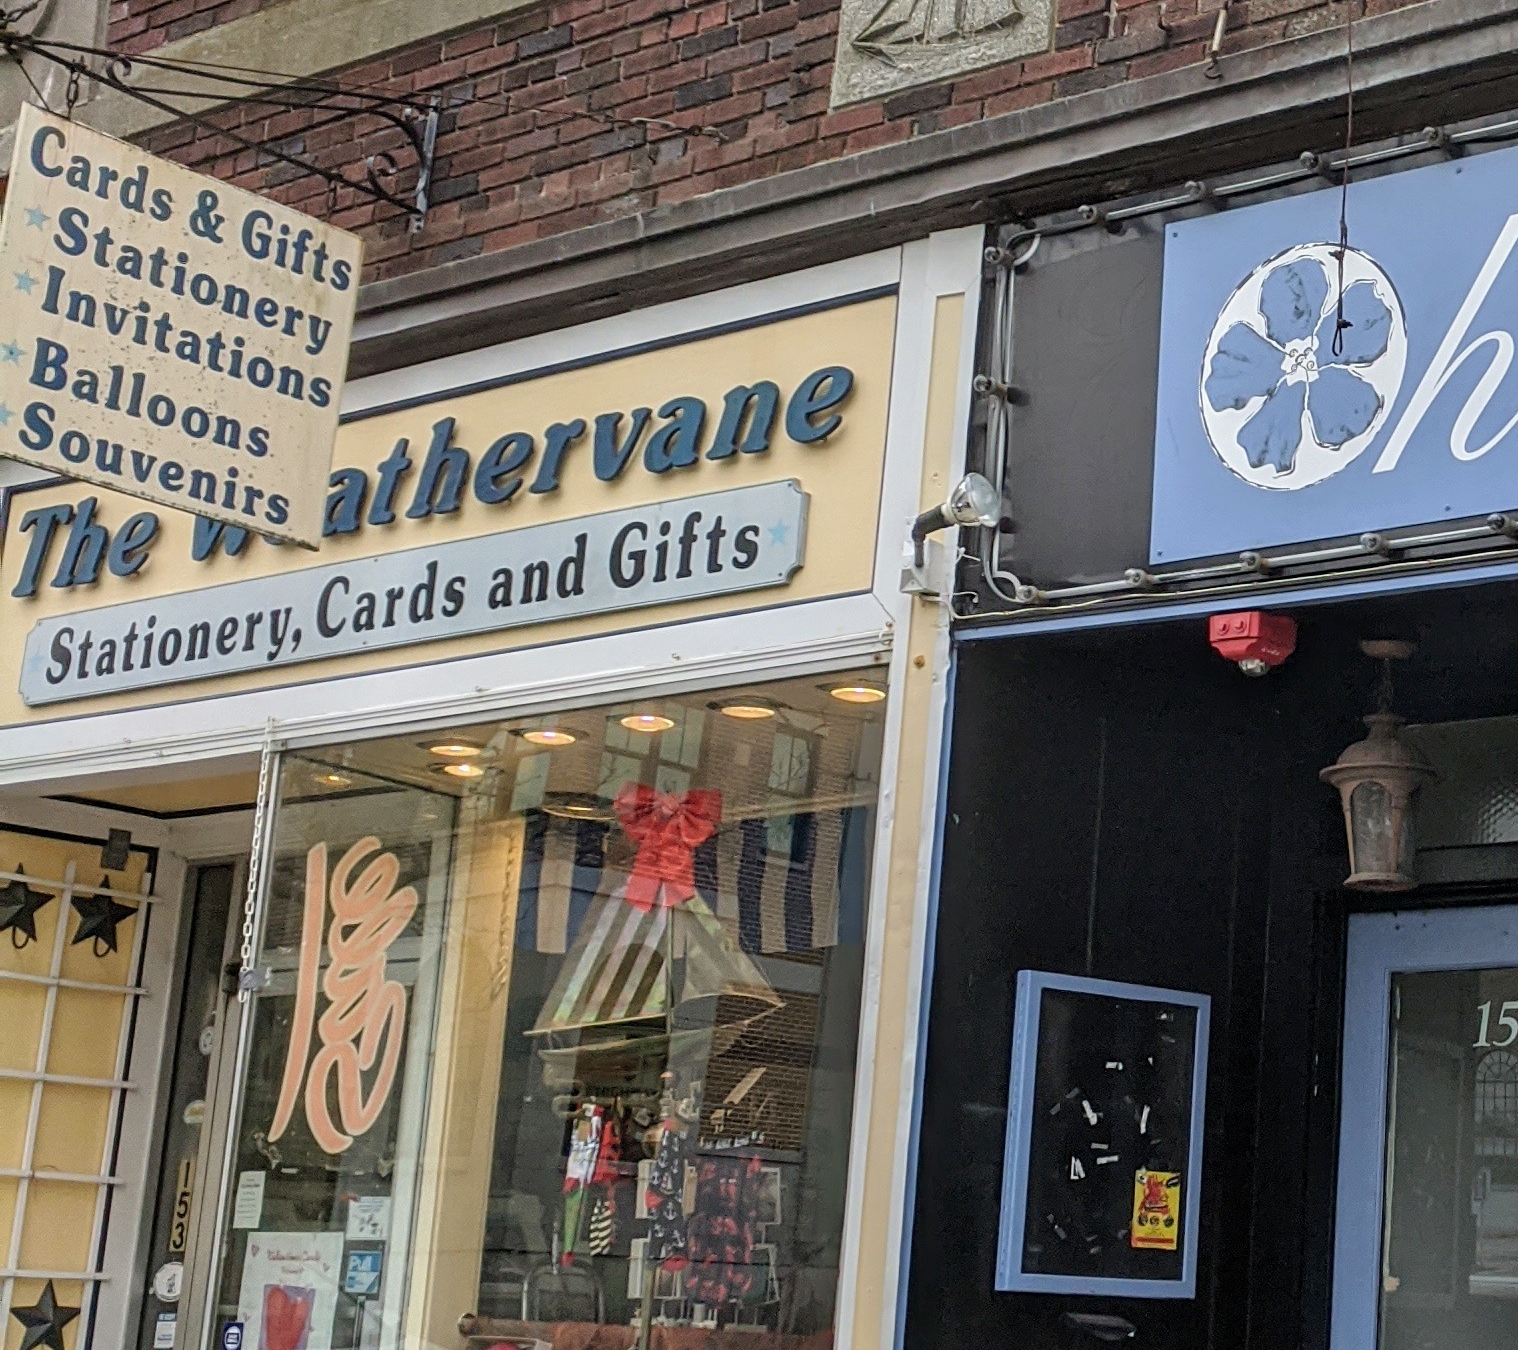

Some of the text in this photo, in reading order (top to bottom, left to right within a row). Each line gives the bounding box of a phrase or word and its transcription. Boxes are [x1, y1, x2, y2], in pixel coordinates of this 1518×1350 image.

[30, 126, 352, 291] Cards & Gifts
[53, 207, 333, 355] Stationery
[29, 337, 270, 457] Balloons
[41, 265, 333, 408] Invitations
[11, 364, 856, 598] The athervane
[18, 401, 289, 525] Souvenirs
[44, 509, 761, 685] Stationery, Cards and Gifts
[171, 1161, 191, 1249] 153
